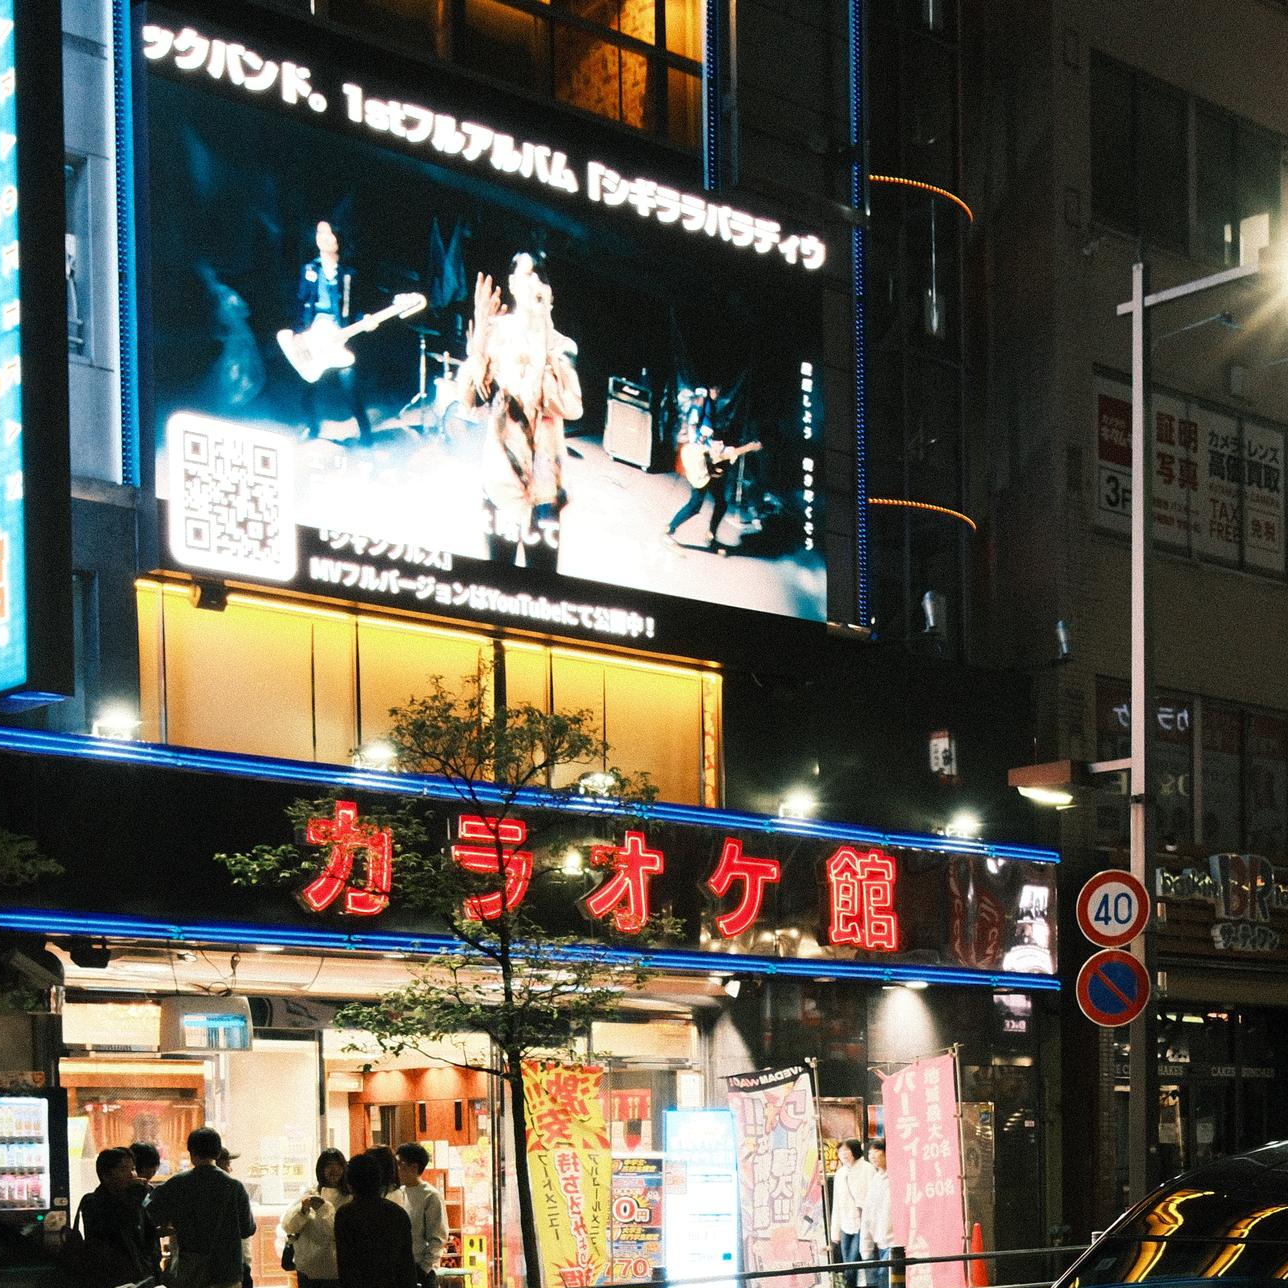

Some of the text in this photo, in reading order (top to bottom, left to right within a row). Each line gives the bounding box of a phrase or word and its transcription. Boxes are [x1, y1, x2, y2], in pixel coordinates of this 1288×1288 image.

[342, 83, 579, 193] 1stフルアルバム
[1156, 411, 1199, 454] 証明
[1105, 475, 1132, 509] 3F
[1156, 452, 1199, 492] 写真
[1209, 497, 1240, 525] TAX
[302, 799, 900, 953] カラオケ館
[1210, 852, 1274, 923] BR
[1094, 892, 1133, 926] 40
